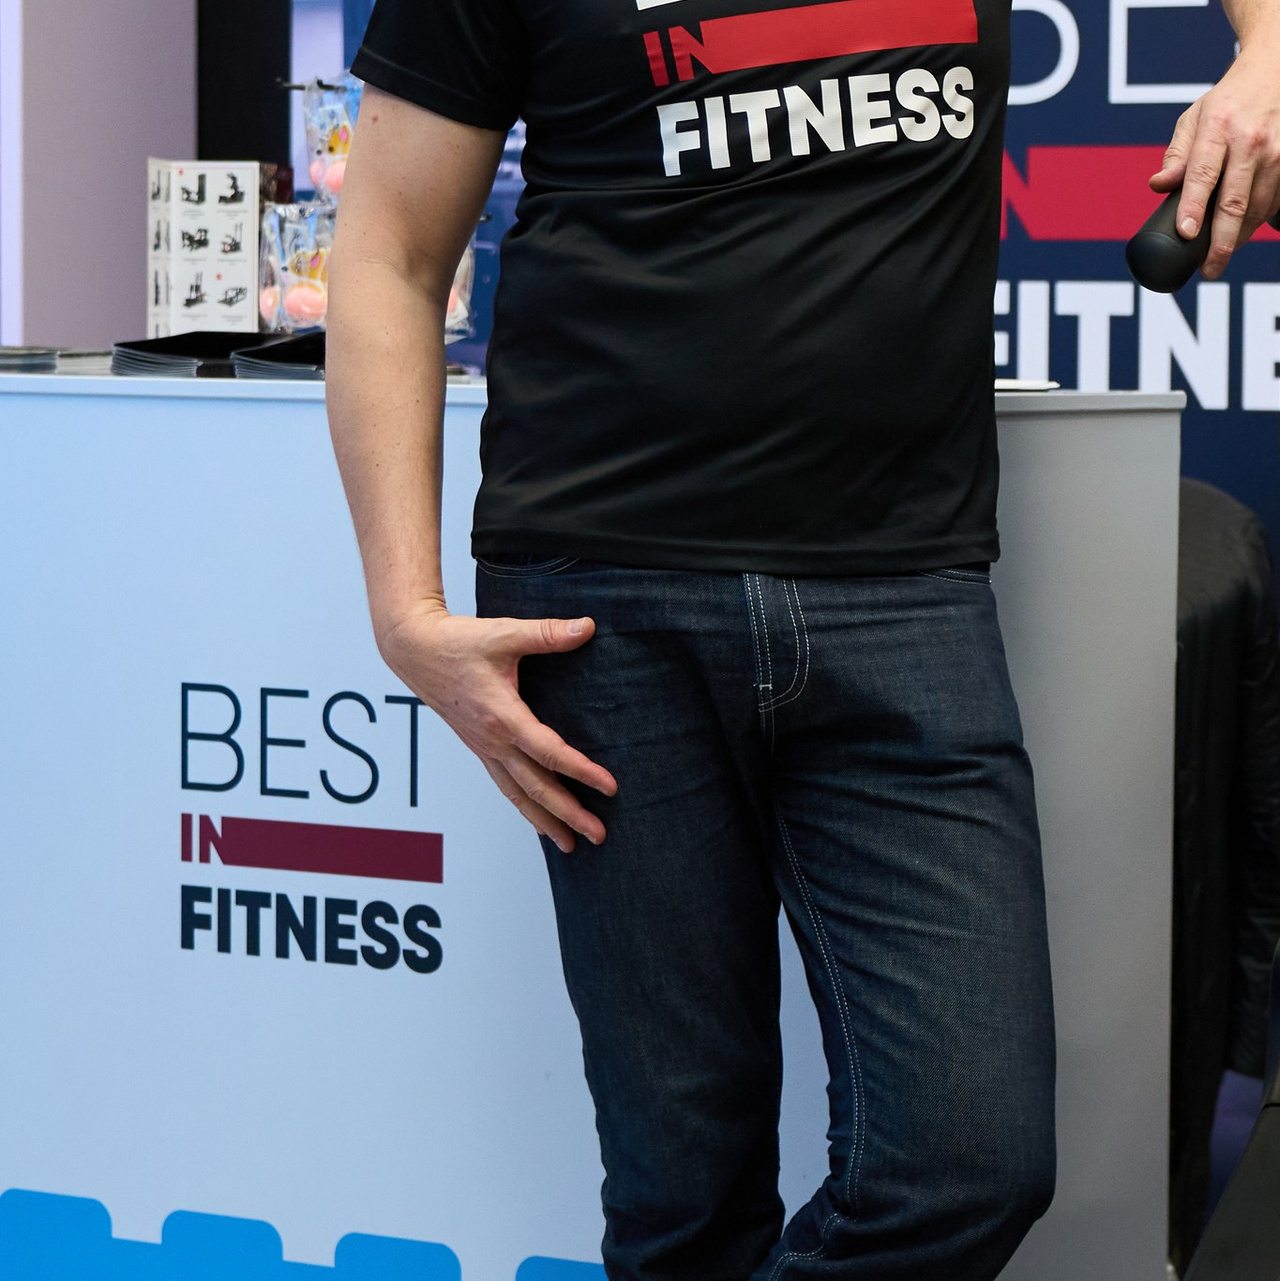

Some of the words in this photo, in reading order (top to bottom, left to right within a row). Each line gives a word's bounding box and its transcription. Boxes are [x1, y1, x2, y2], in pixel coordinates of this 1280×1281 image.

[643, 22, 719, 87] IN
[656, 66, 975, 178] FITNESS
[181, 682, 427, 808] BEST
[181, 812, 226, 866] IN
[181, 884, 443, 975] FITNESS
